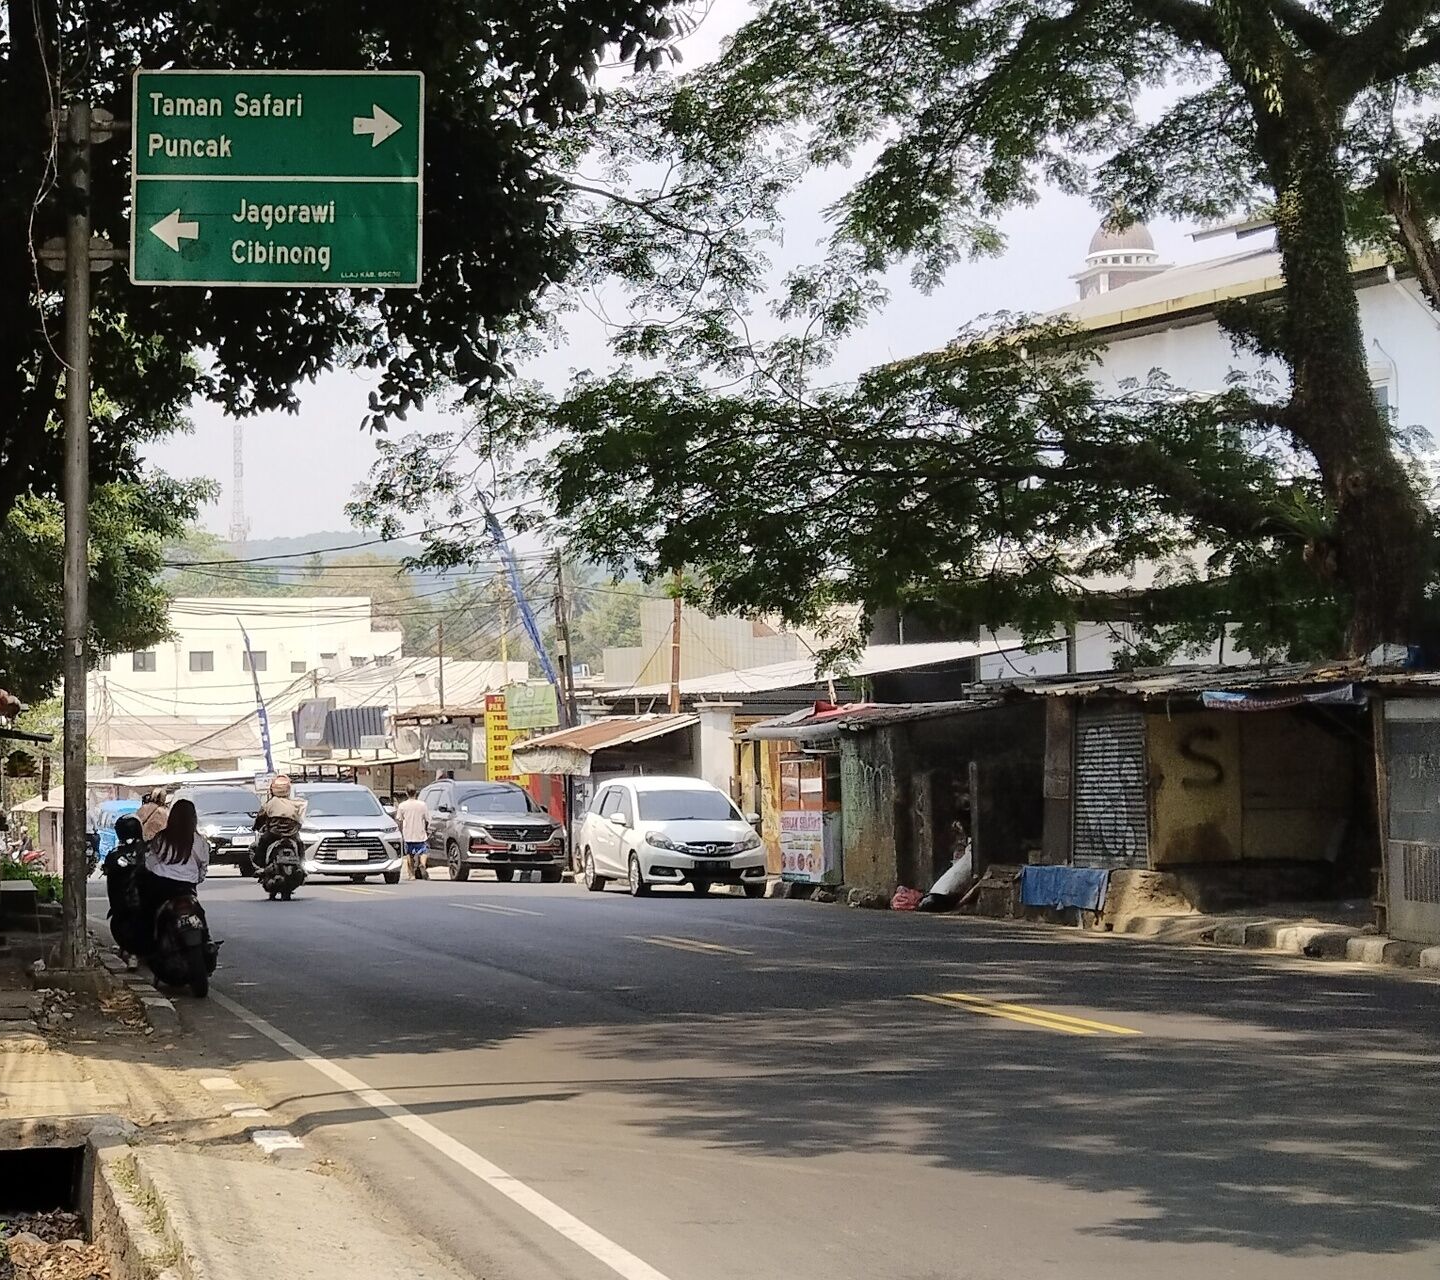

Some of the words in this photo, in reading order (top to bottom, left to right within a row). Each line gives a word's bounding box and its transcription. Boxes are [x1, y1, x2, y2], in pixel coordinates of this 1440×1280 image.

[149, 93, 222, 117] Taman
[234, 93, 302, 117] Safari
[148, 134, 232, 158] Puncak
[232, 199, 335, 230] Jagorawi
[231, 240, 331, 272] Cibinong
